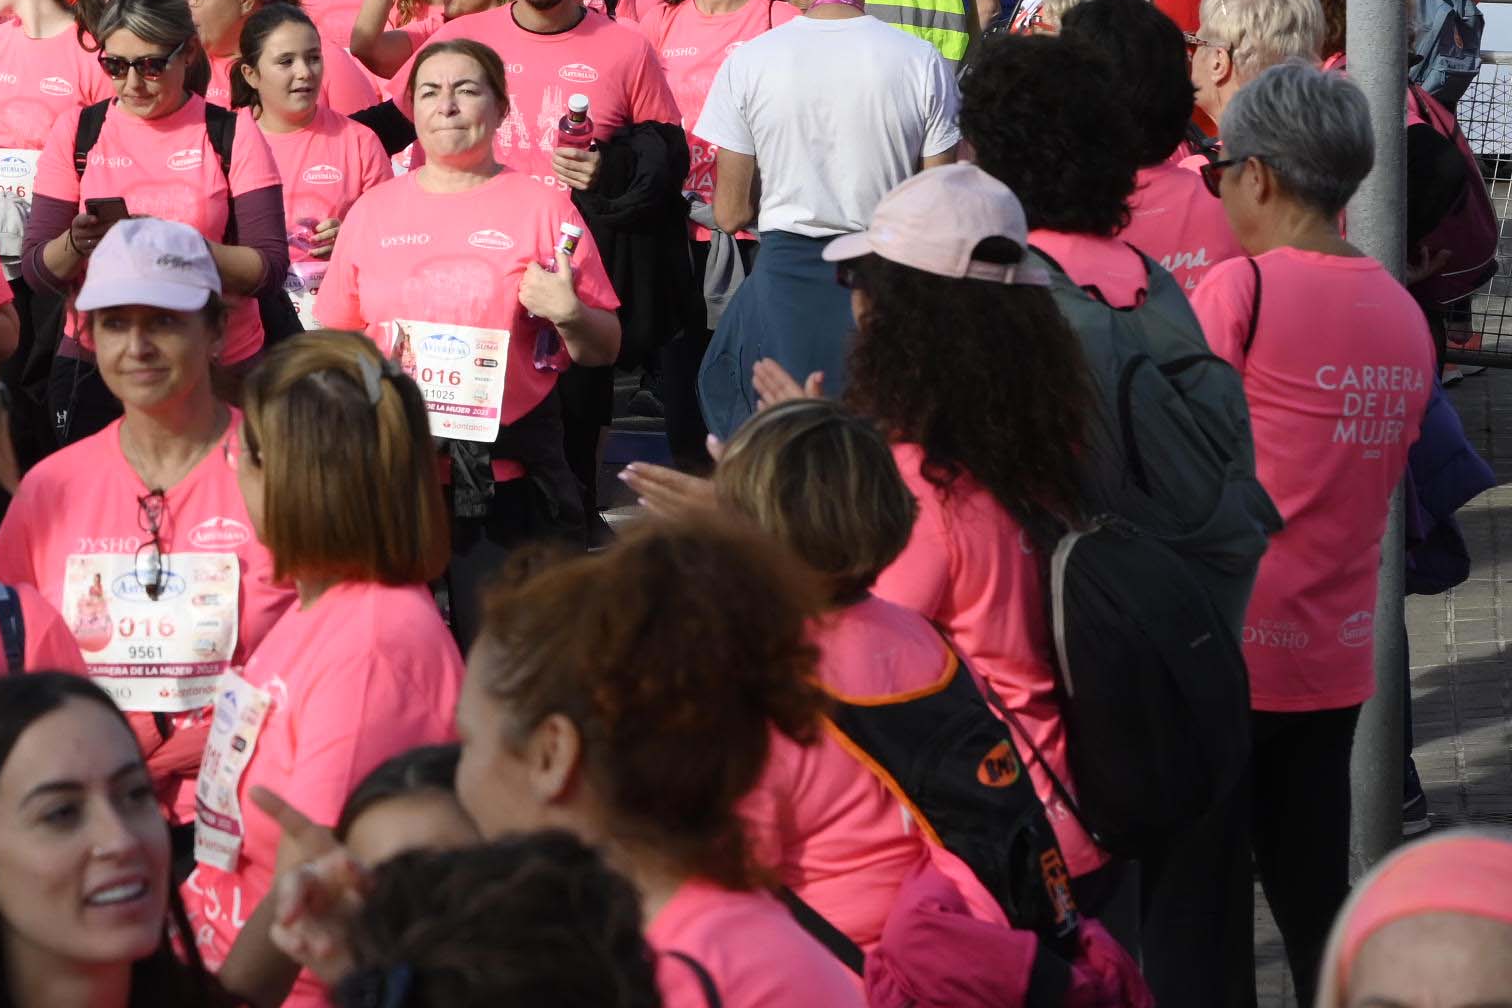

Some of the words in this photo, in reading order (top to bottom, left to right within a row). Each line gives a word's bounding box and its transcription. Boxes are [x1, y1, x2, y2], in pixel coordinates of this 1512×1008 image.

[421, 367, 462, 386] 016
[1315, 364, 1425, 393] CARRERA
[424, 388, 455, 401] 11025
[436, 403, 445, 411] LA
[1343, 393, 1376, 418] DE
[1385, 394, 1407, 418] LA
[1331, 419, 1405, 444] MUJER
[119, 616, 175, 638] 016
[128, 646, 163, 659] 9561
[130, 666, 144, 676] DE
[145, 666, 158, 676] LA
[159, 665, 193, 676] MUJER
